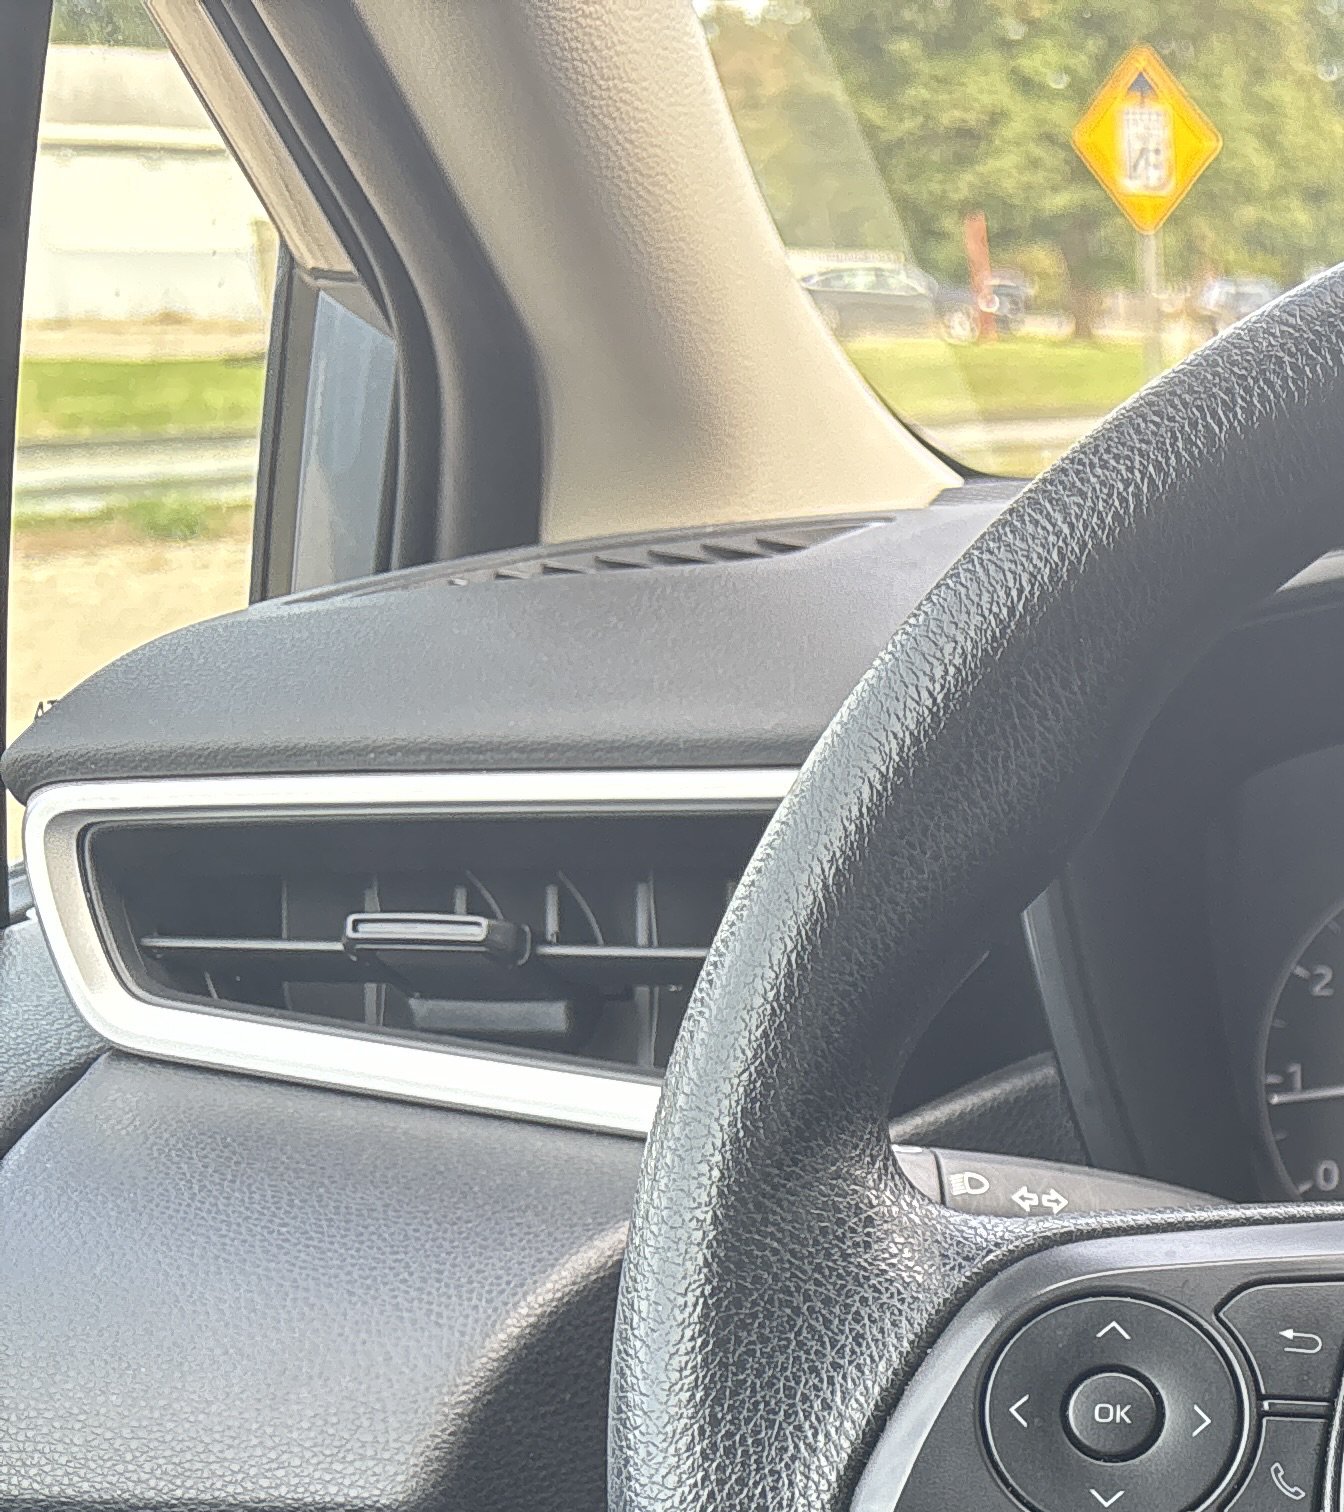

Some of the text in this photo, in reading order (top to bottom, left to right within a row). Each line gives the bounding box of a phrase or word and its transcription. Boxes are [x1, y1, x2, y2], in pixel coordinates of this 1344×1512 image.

[1308, 966, 1334, 997] 2
[1316, 1161, 1339, 1192] 0
[1093, 1403, 1132, 1425] OK
